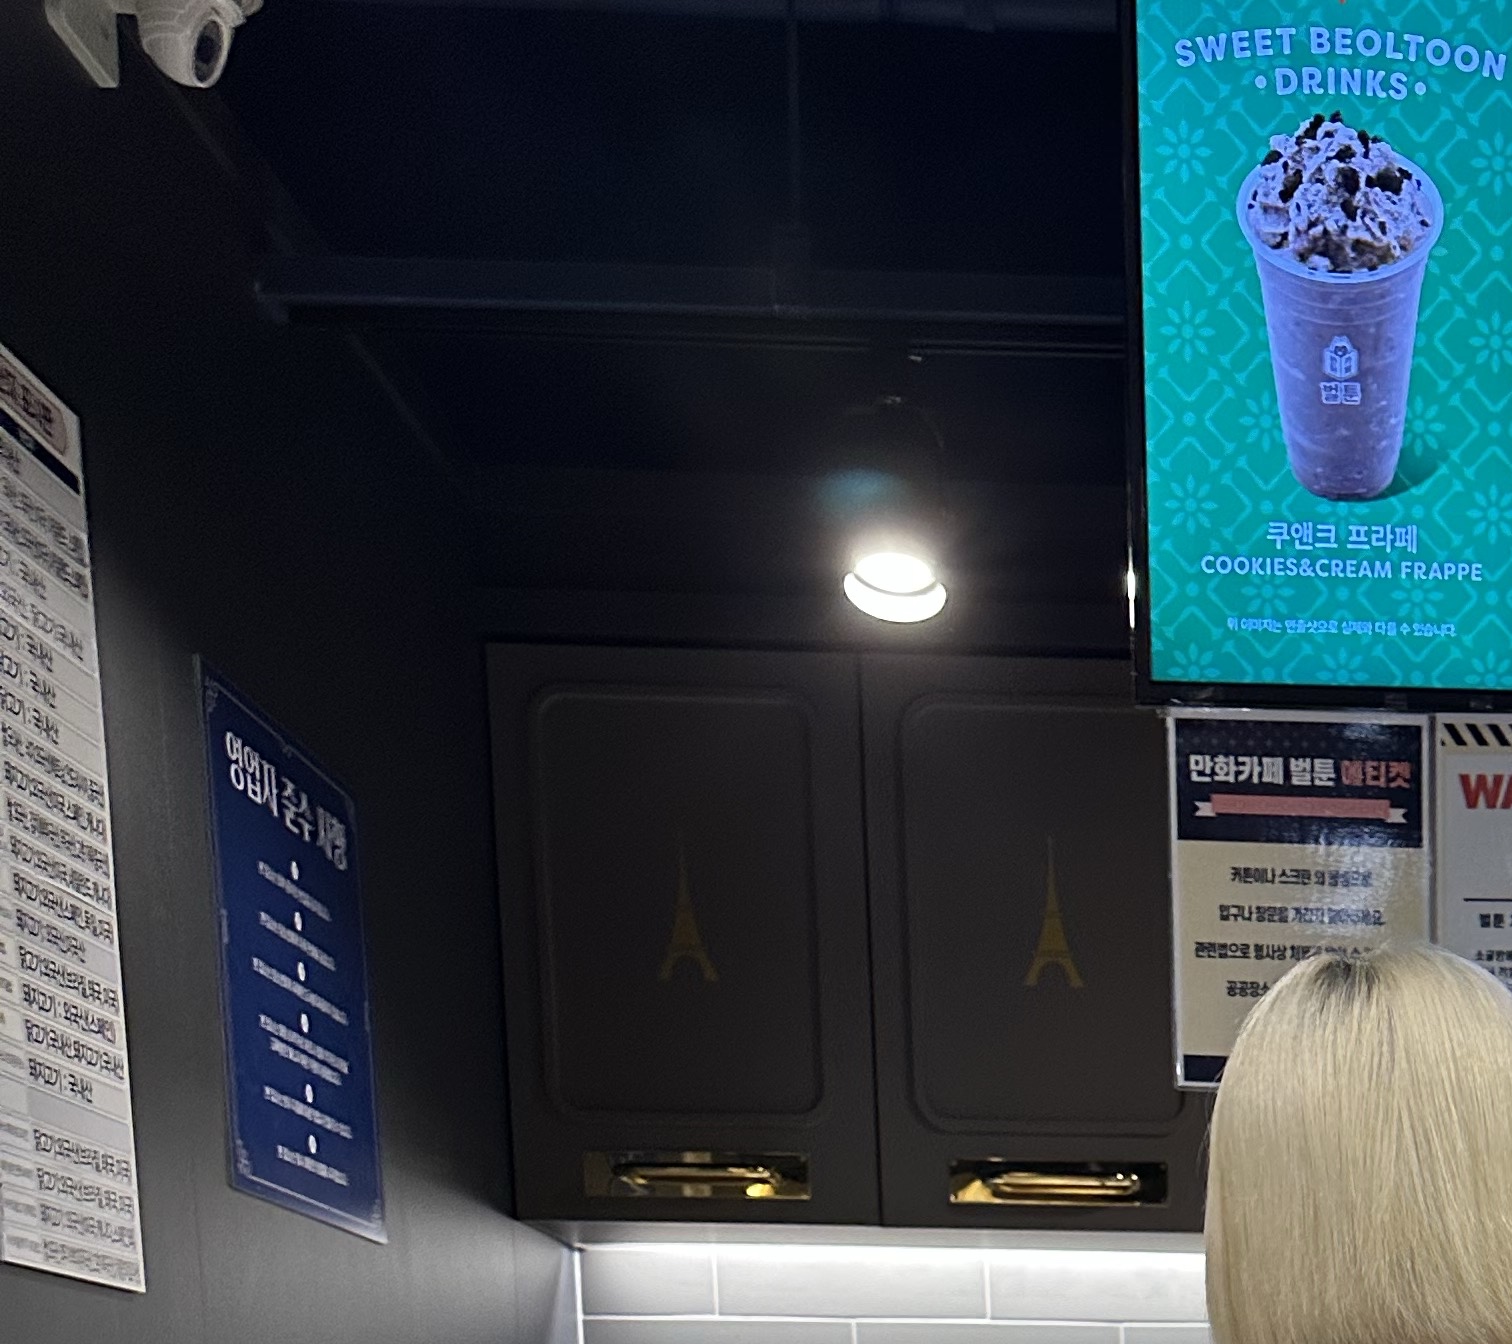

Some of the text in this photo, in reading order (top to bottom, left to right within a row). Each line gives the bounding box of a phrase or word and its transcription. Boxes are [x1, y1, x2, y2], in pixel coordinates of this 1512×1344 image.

[1174, 27, 1506, 81] SWEET BEOLTOON
[1275, 67, 1408, 100] DRINKS
[1267, 521, 1417, 553] 쿠앤크 프라페
[1201, 556, 1482, 581] COOKIES&CREAM FRAPPE
[1189, 754, 1284, 784] 만화카페
[1290, 758, 1336, 786] 벌툰
